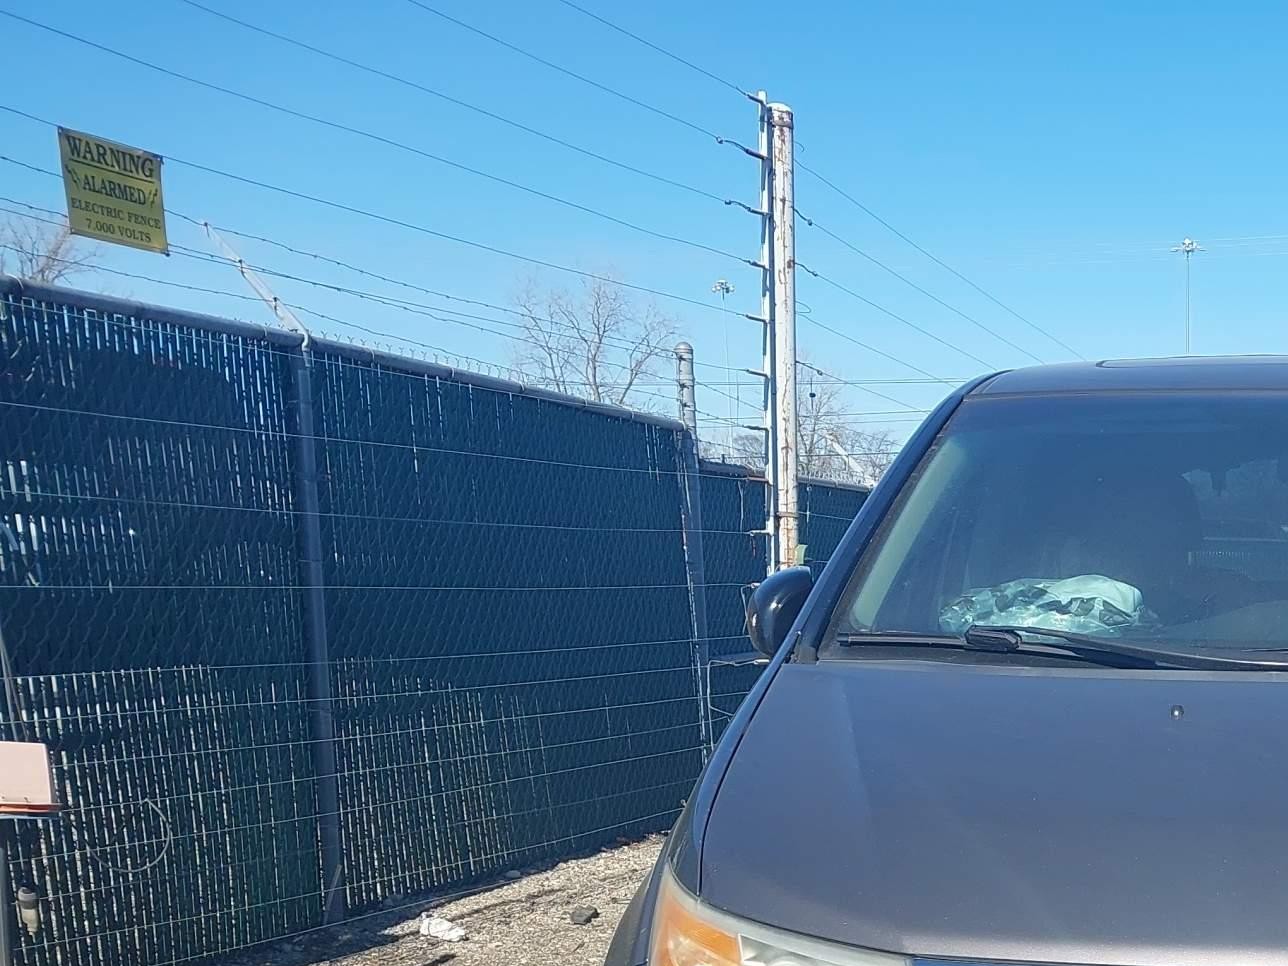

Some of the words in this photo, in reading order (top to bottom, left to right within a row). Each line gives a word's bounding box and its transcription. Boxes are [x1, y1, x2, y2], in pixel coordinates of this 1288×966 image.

[65, 135, 154, 178] WARNING
[83, 174, 146, 205] ALARMED
[71, 197, 125, 220] ELECTRIC
[128, 211, 161, 230] FENCE
[118, 226, 151, 243] VOLTS
